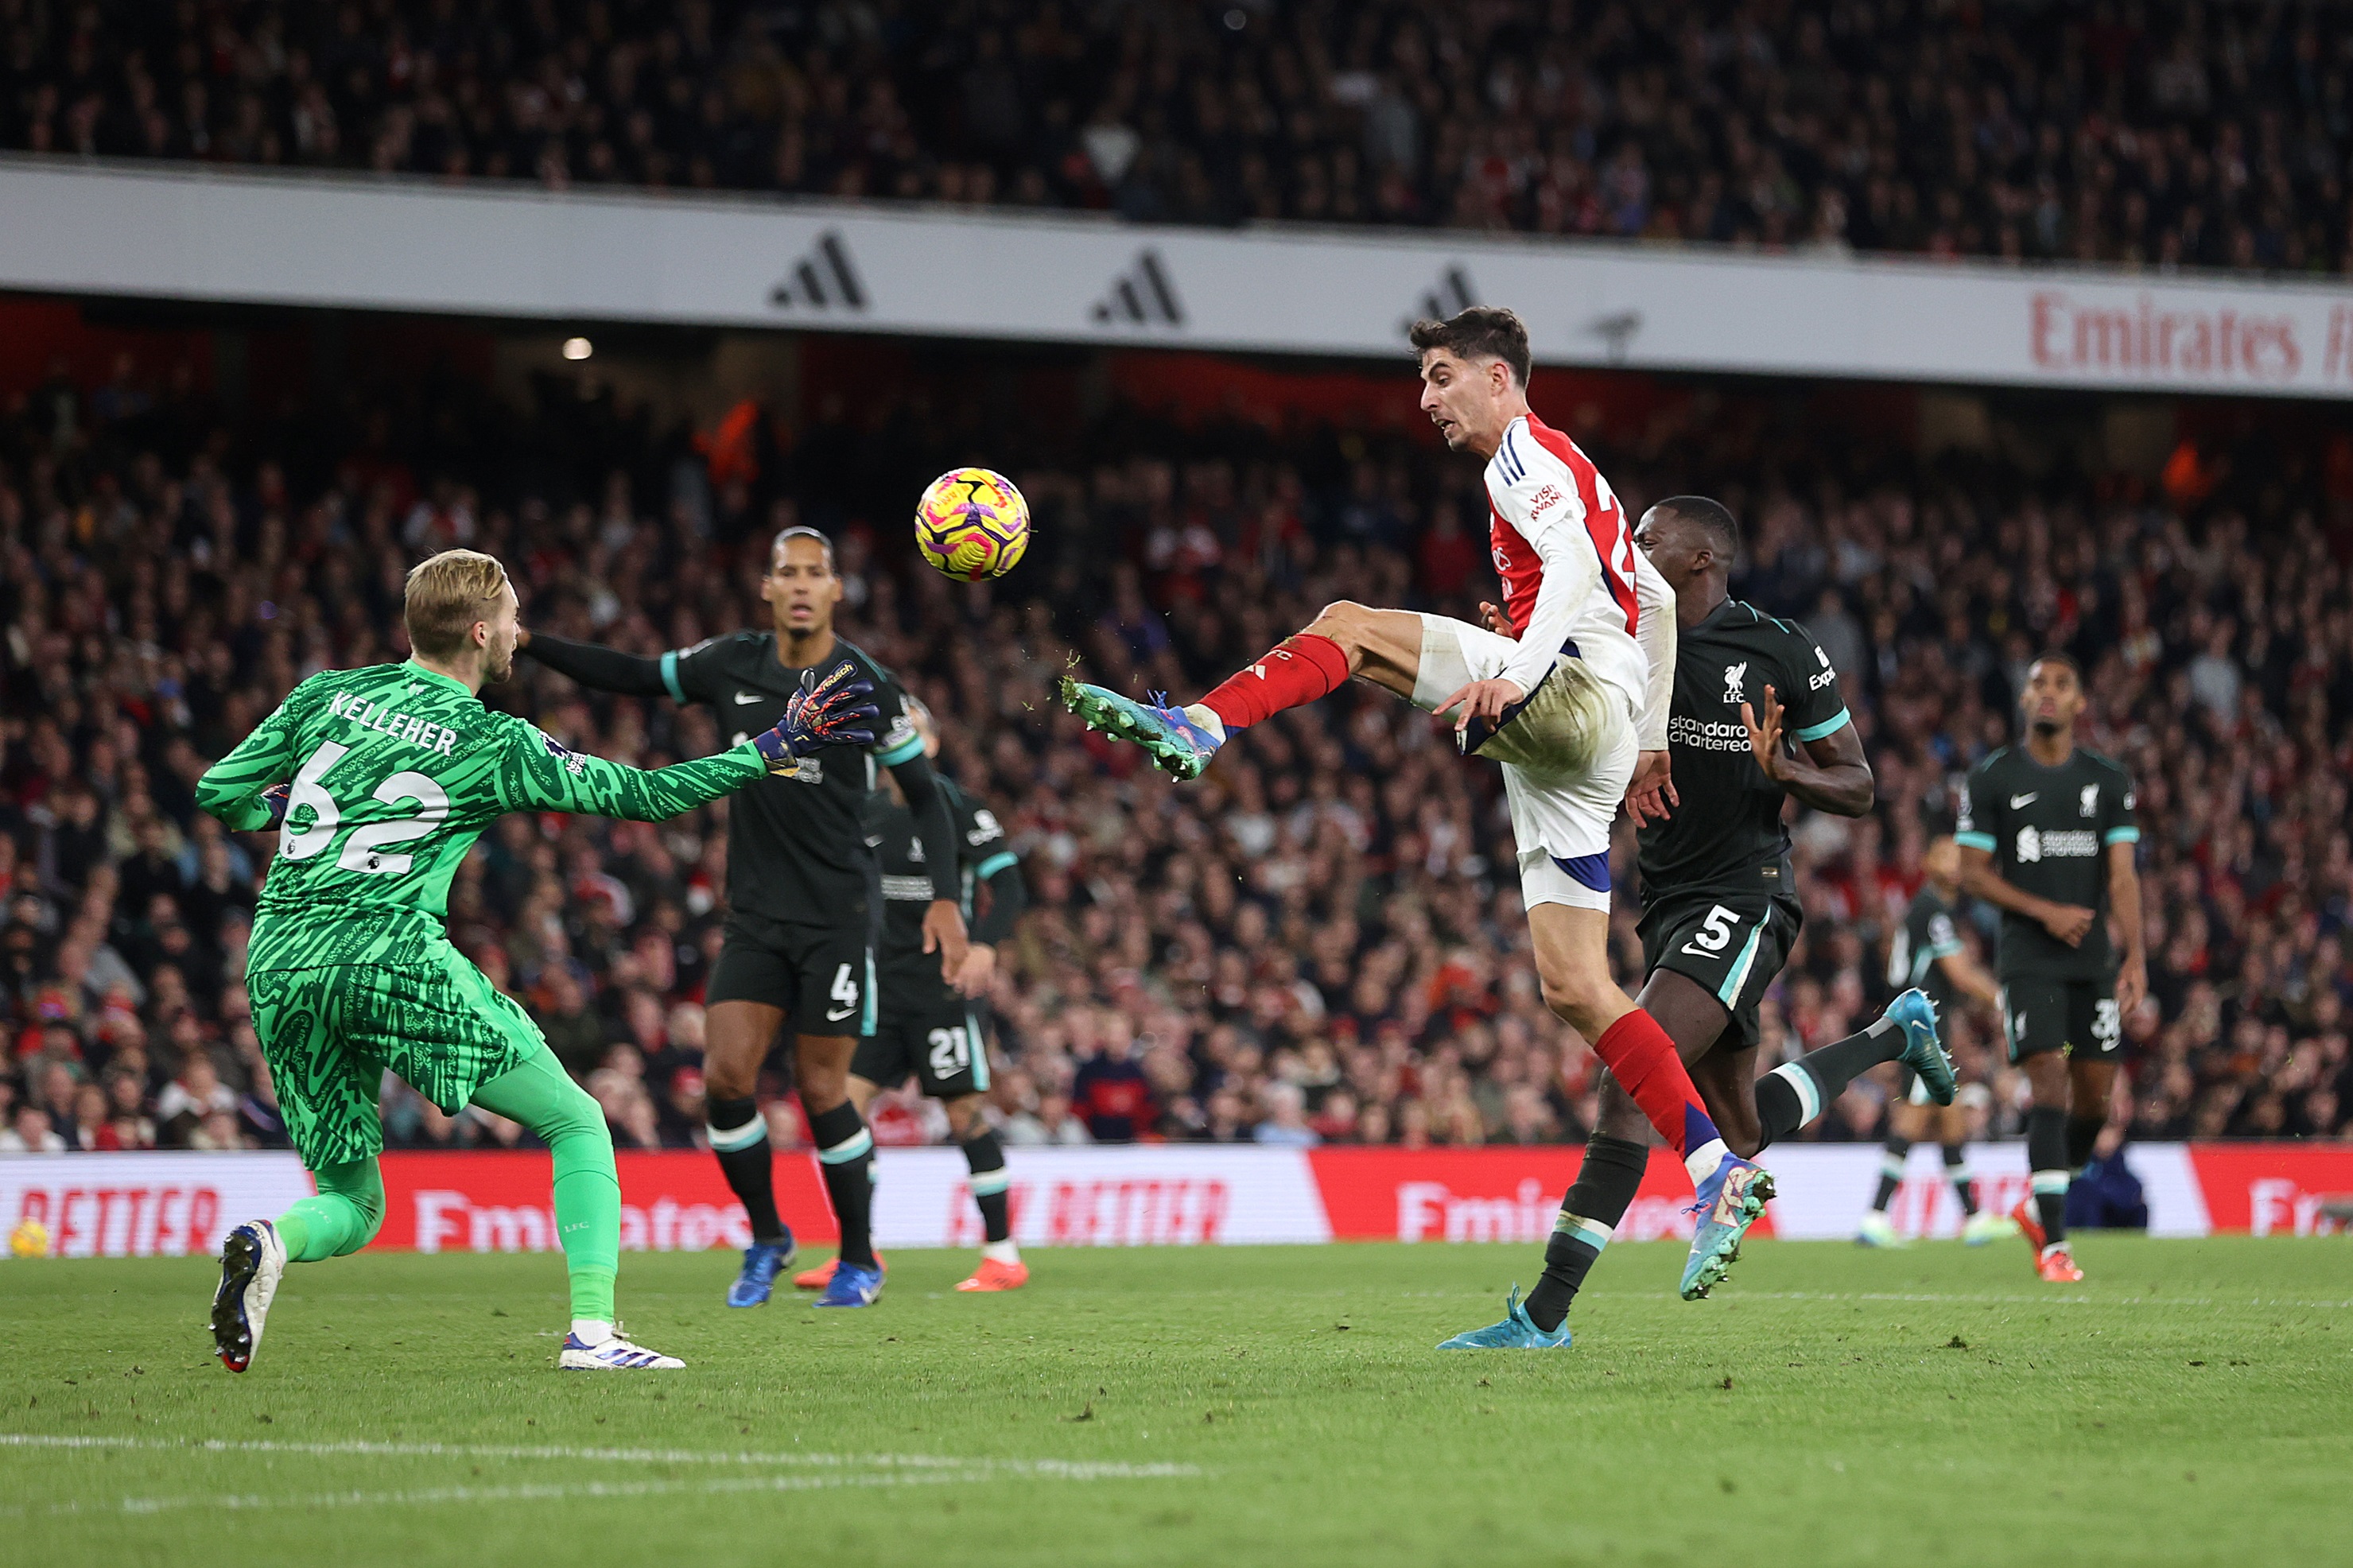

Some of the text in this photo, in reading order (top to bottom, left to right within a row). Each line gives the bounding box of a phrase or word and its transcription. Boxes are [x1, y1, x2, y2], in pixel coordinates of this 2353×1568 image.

[2030, 291, 2301, 382] Emirates
[822, 664, 853, 690] reusch
[328, 690, 457, 756] KELLEHER
[278, 739, 451, 875] 62
[1695, 904, 1741, 951] 5
[830, 963, 859, 1007] 4
[928, 1027, 970, 1069] 21
